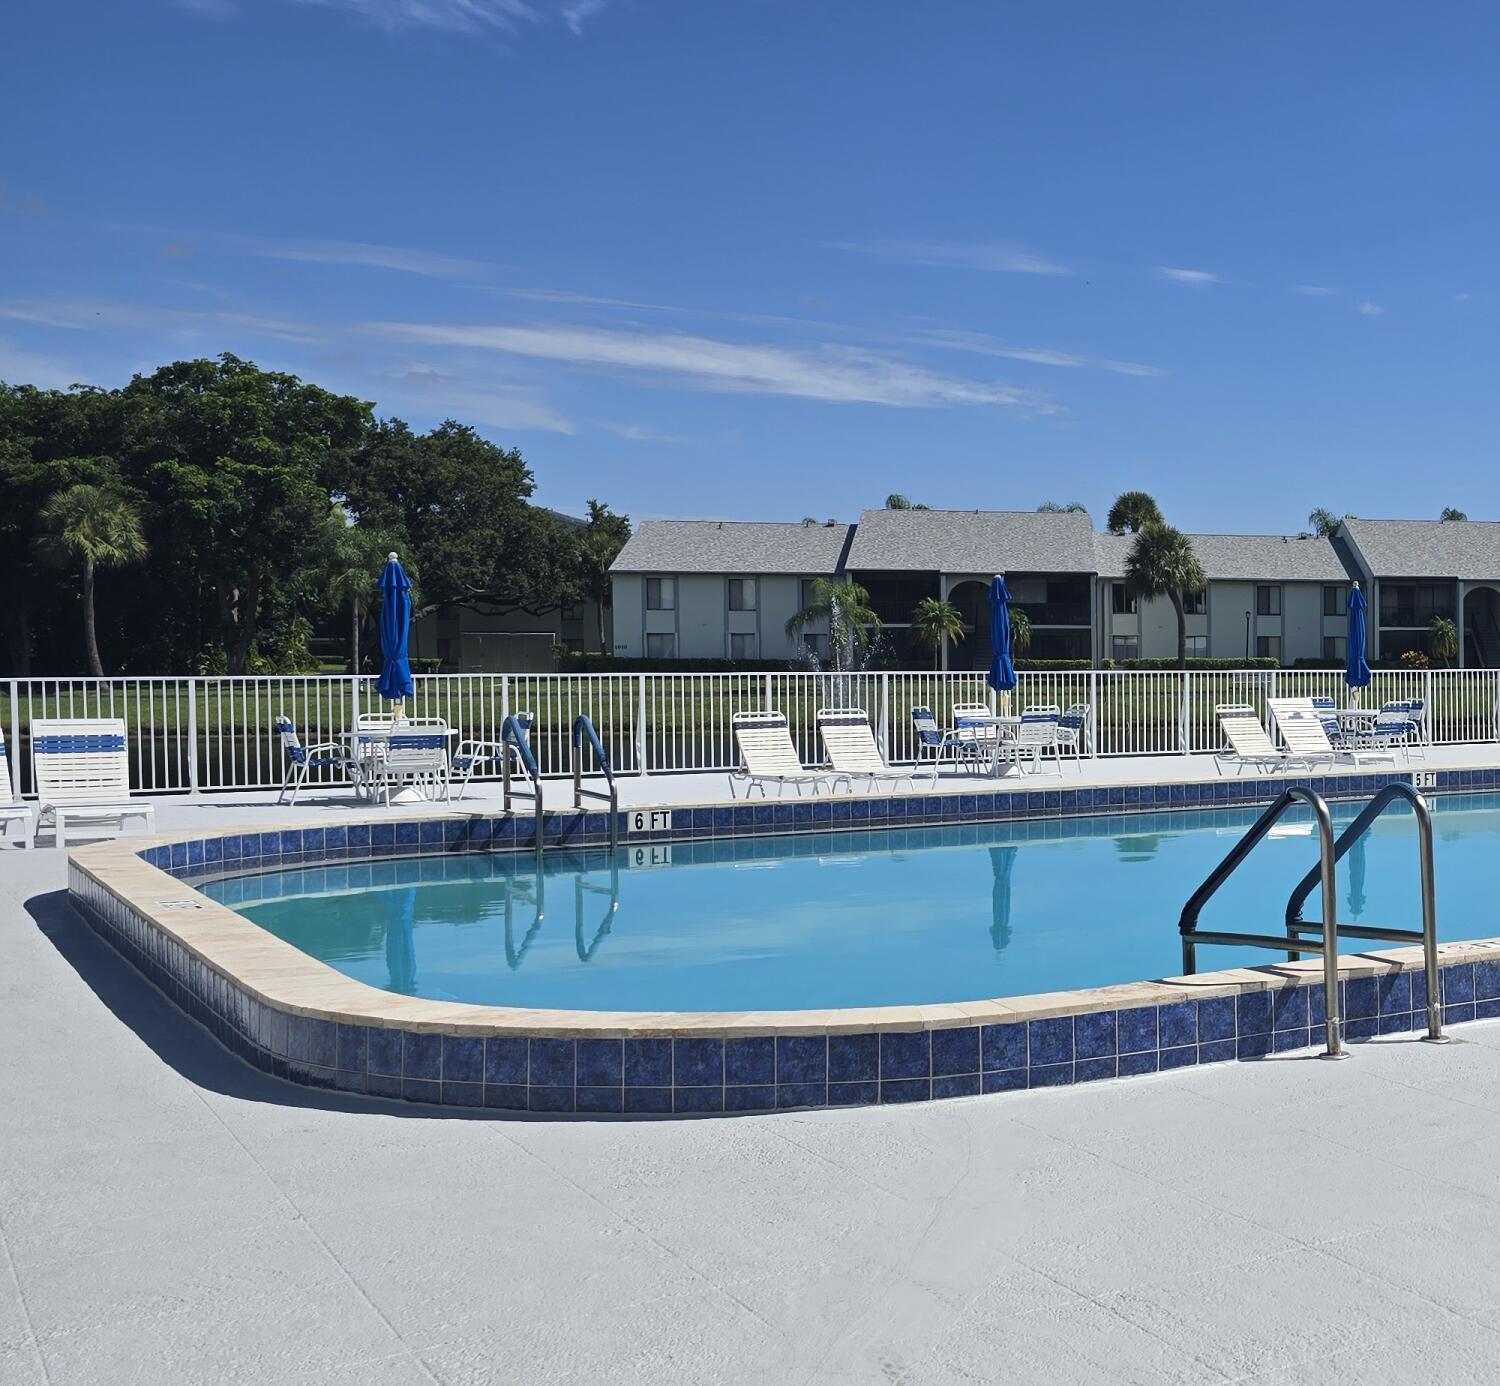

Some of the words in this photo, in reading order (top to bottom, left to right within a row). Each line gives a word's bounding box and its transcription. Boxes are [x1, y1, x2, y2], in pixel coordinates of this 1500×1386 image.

[1416, 773, 1421, 787] 5
[1424, 772, 1436, 786] FT
[635, 812, 644, 830] 6
[650, 811, 670, 830] FT
